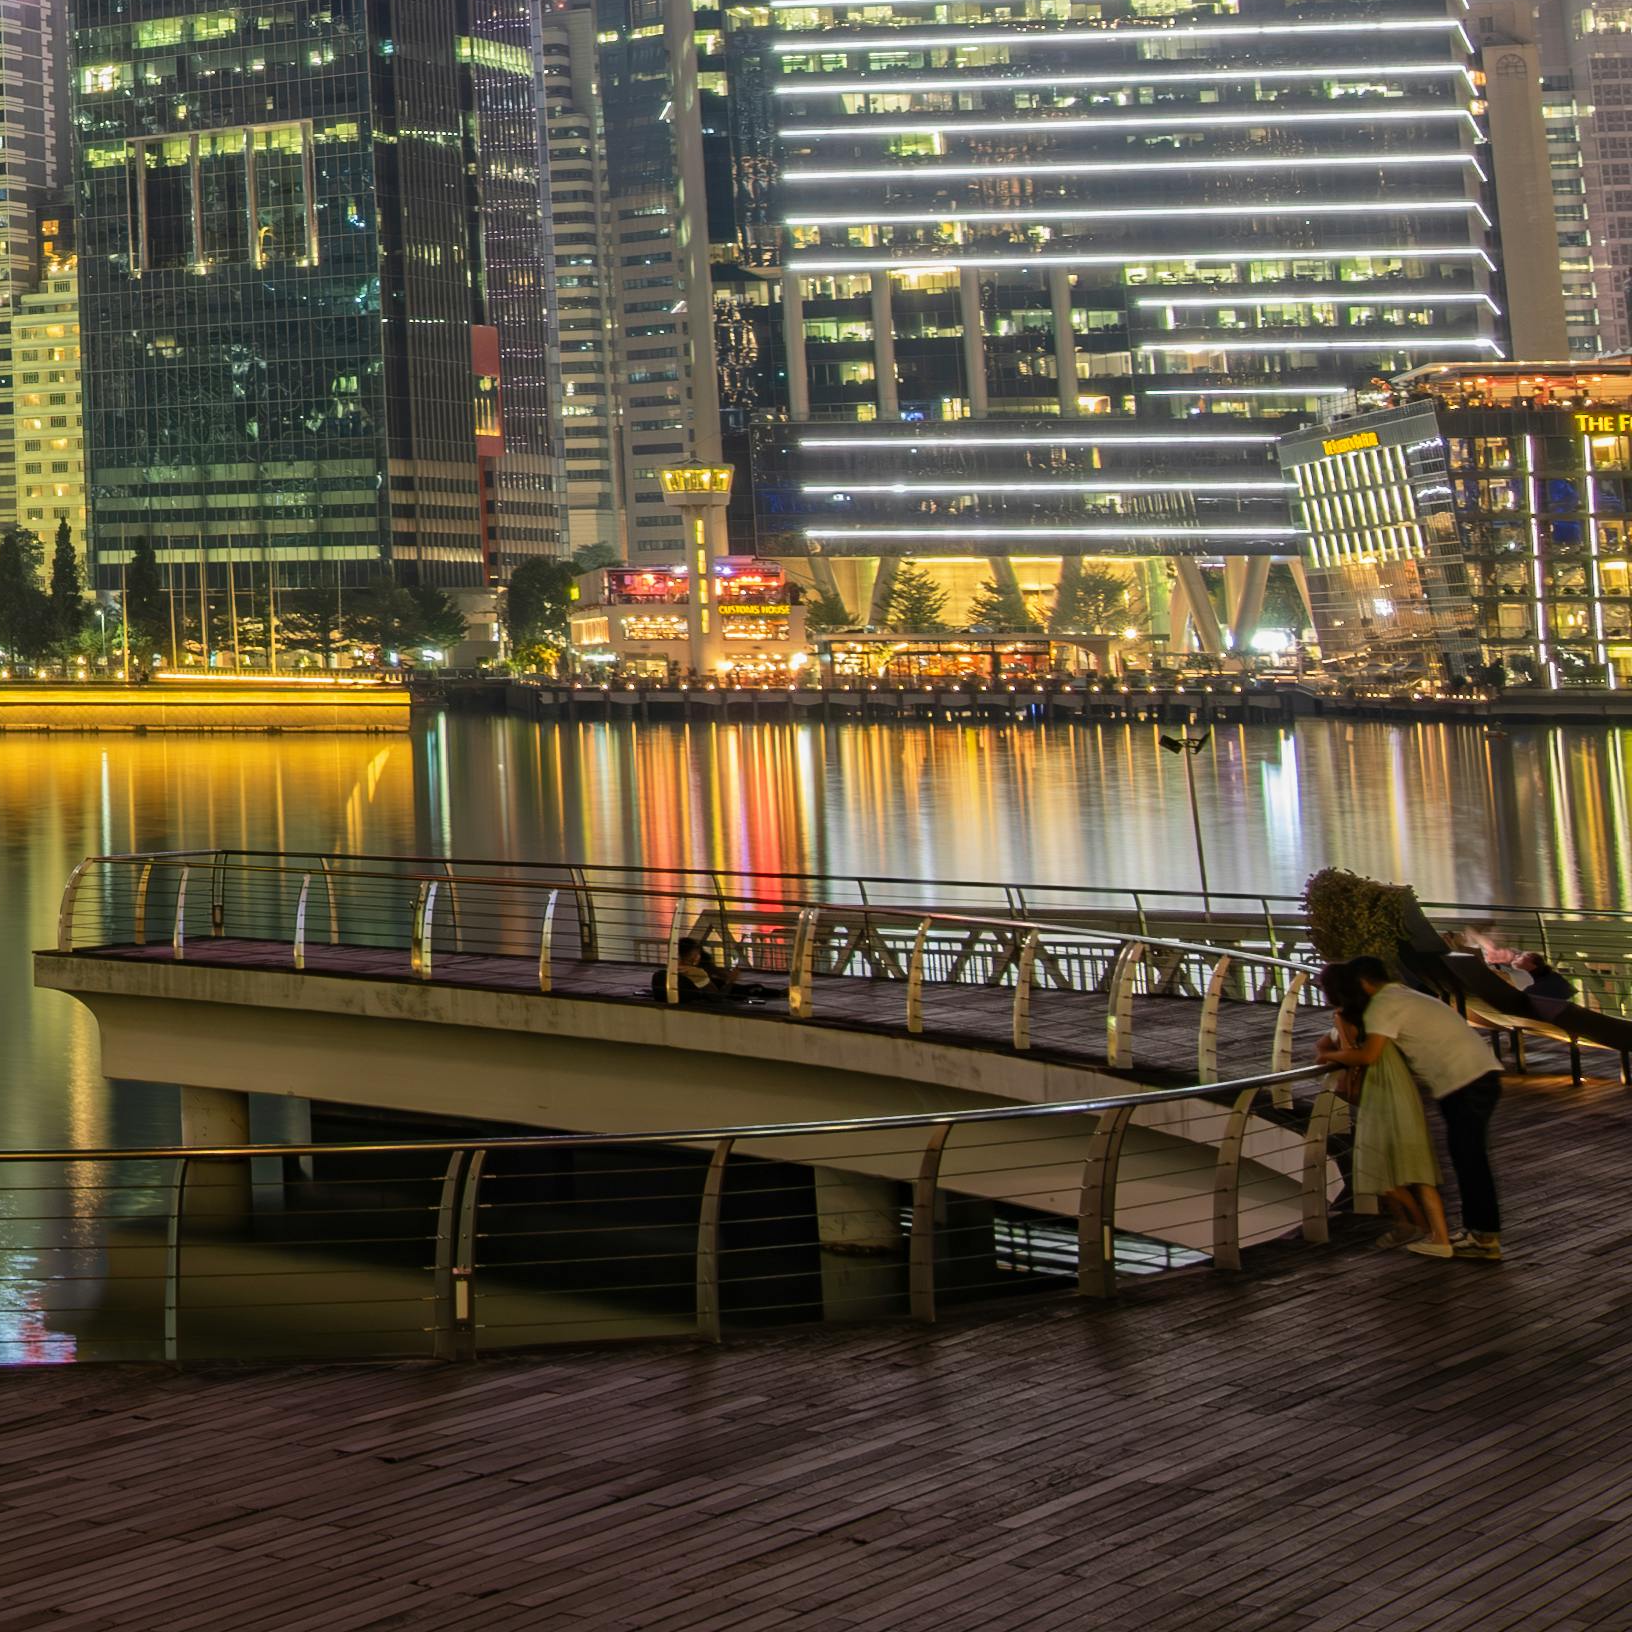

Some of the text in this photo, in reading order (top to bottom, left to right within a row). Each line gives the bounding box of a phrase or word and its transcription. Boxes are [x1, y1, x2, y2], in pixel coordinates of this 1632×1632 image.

[1574, 414, 1632, 432] THE F
[718, 605, 791, 615] CUSTOMS HOUSE
